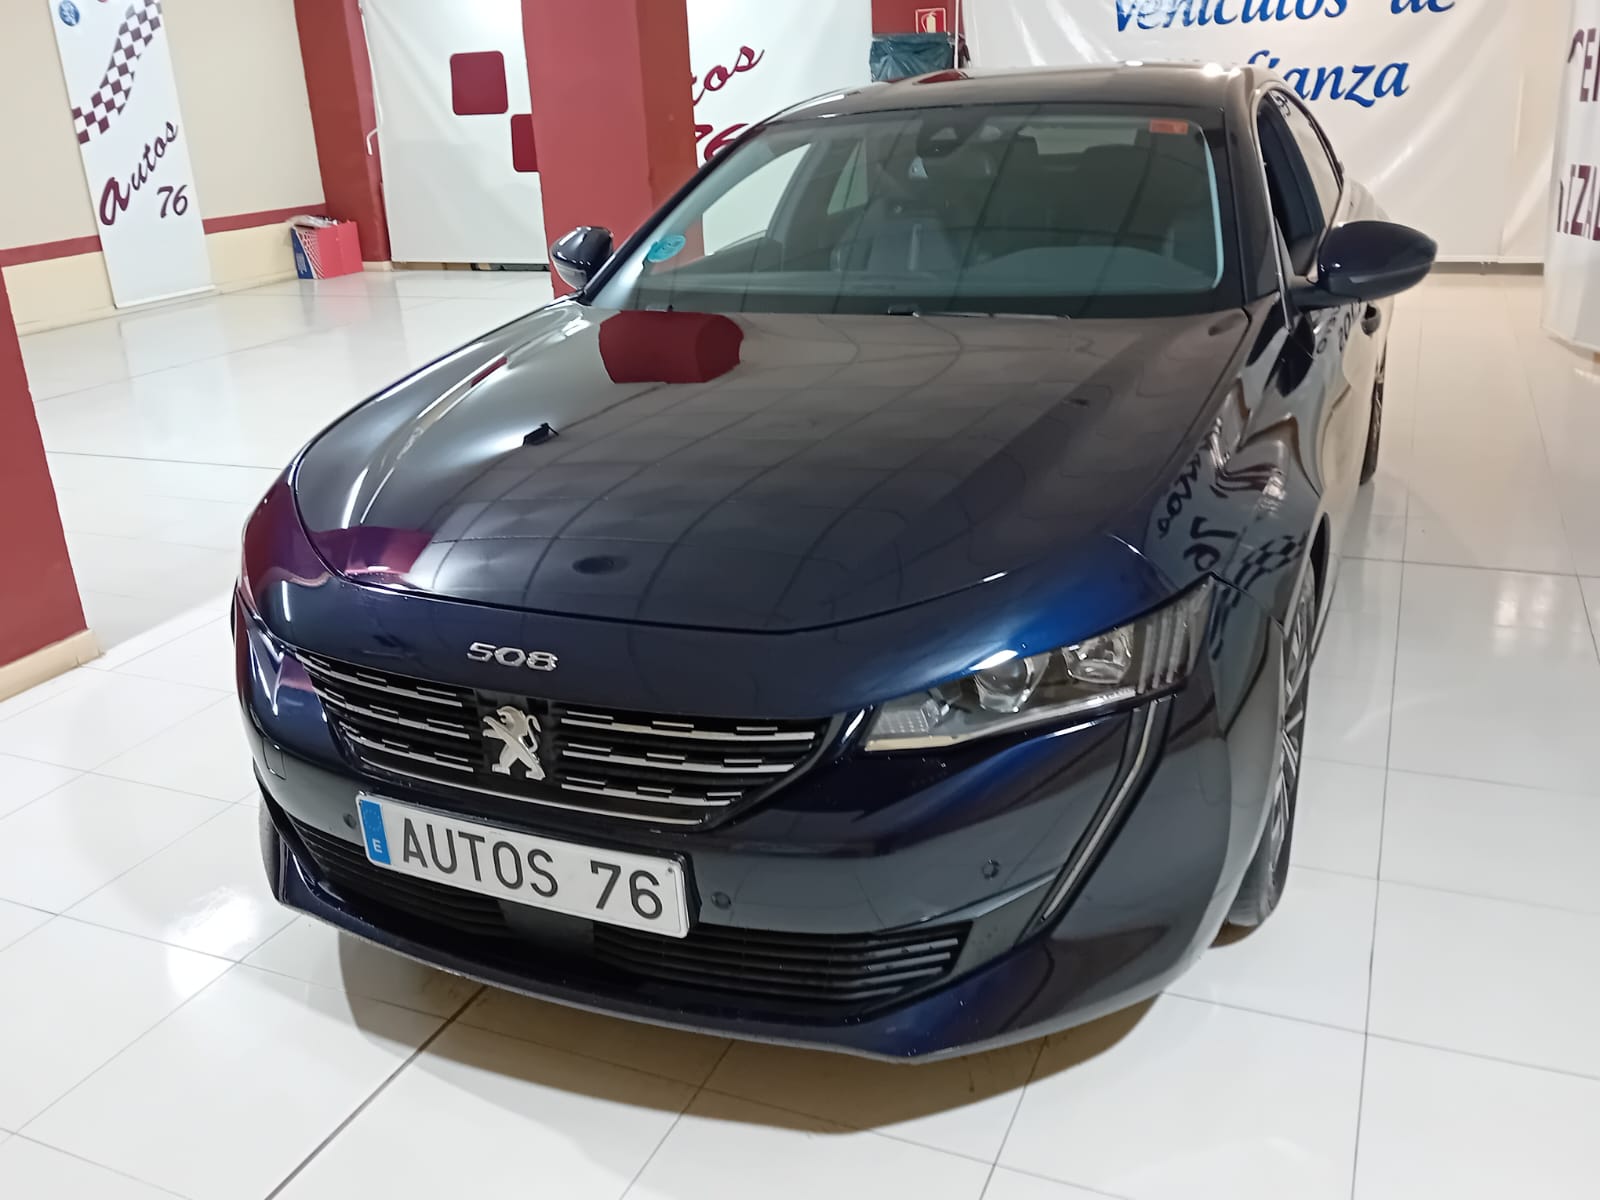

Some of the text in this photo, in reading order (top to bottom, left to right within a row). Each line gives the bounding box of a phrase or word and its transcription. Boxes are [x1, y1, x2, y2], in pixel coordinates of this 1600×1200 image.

[156, 184, 188, 217] 76
[467, 641, 559, 671] 508
[373, 838, 382, 853] E
[402, 817, 663, 919] AUTOS 76
